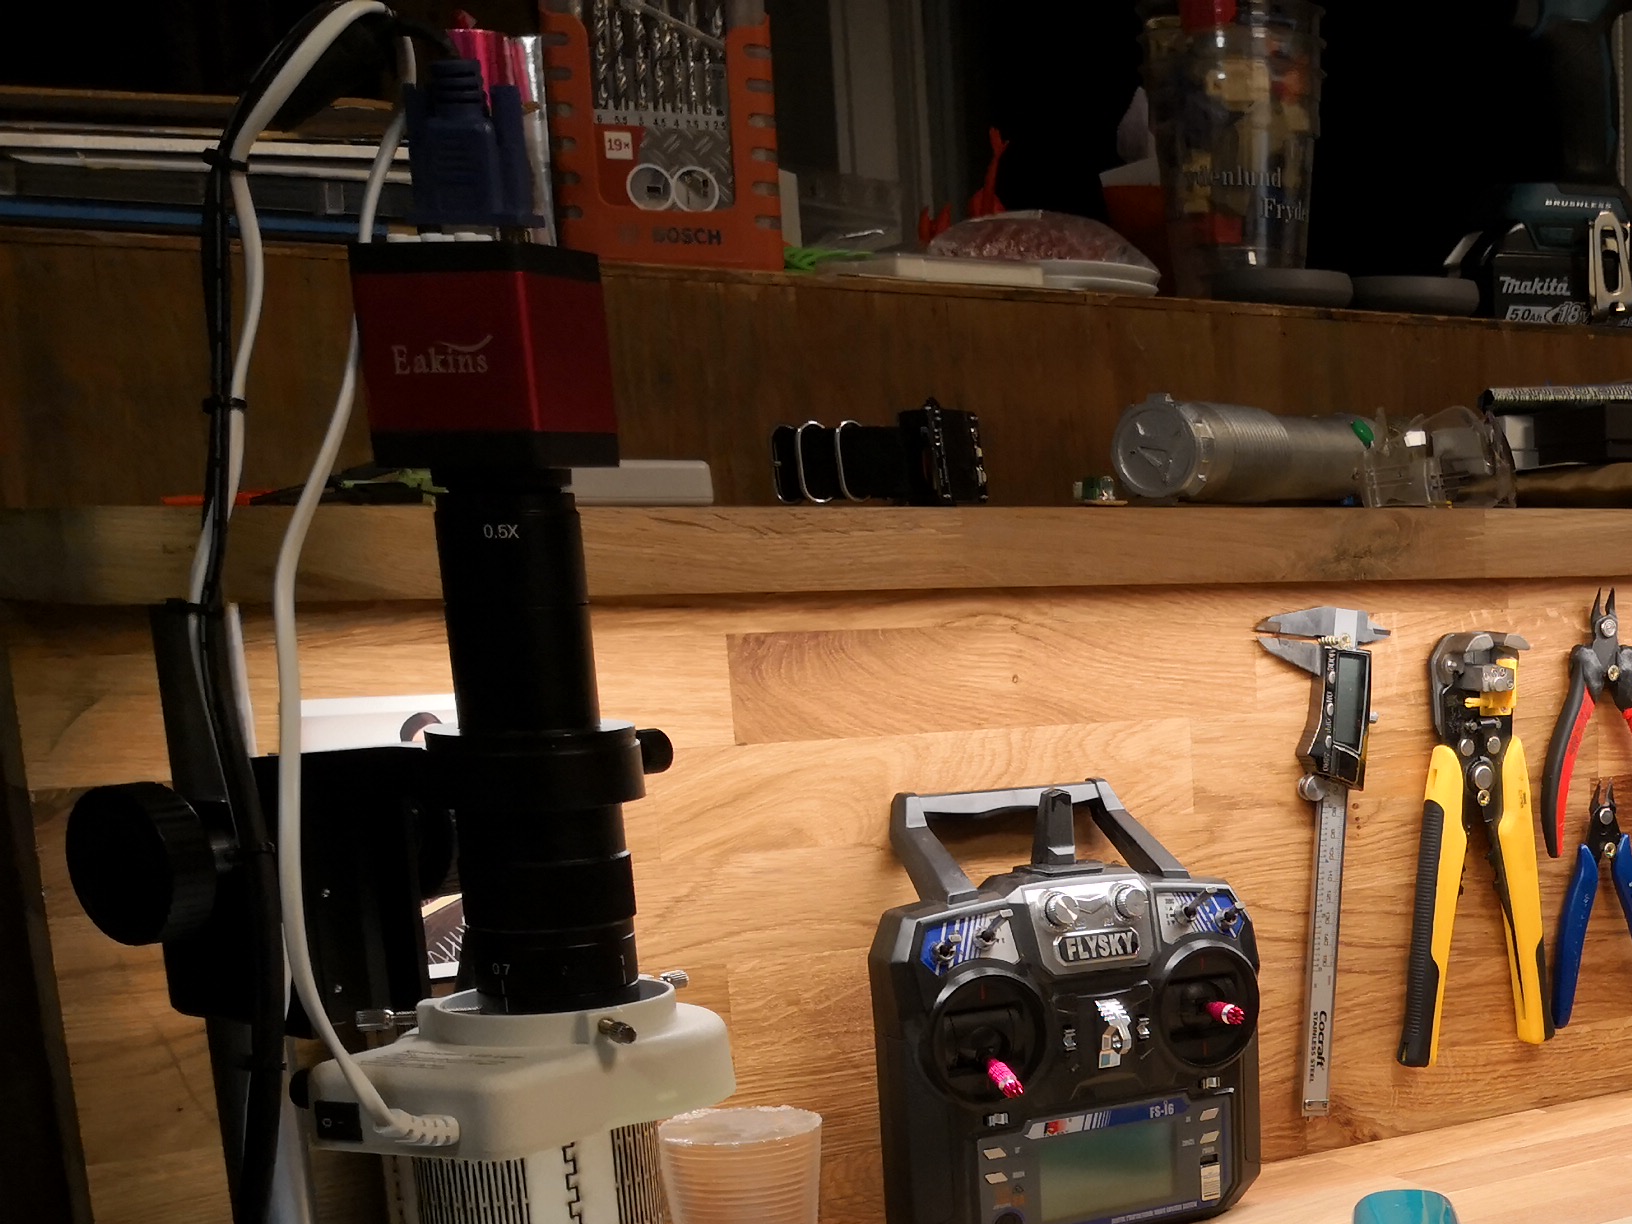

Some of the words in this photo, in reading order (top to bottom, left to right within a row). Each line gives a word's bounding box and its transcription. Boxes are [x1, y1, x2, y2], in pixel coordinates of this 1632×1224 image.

[1544, 199, 1612, 209] BRUSHLESS
[652, 227, 722, 245] BOSCH
[391, 344, 490, 376] Eakins
[483, 523, 520, 539] 0.5X
[1066, 930, 1134, 961] FLYSKY
[1310, 1011, 1319, 1056] STAINLESS
[1317, 1010, 1328, 1067] Cocraft
[1308, 1059, 1316, 1082] STEEL
[1149, 1100, 1175, 1119] FS-i6
